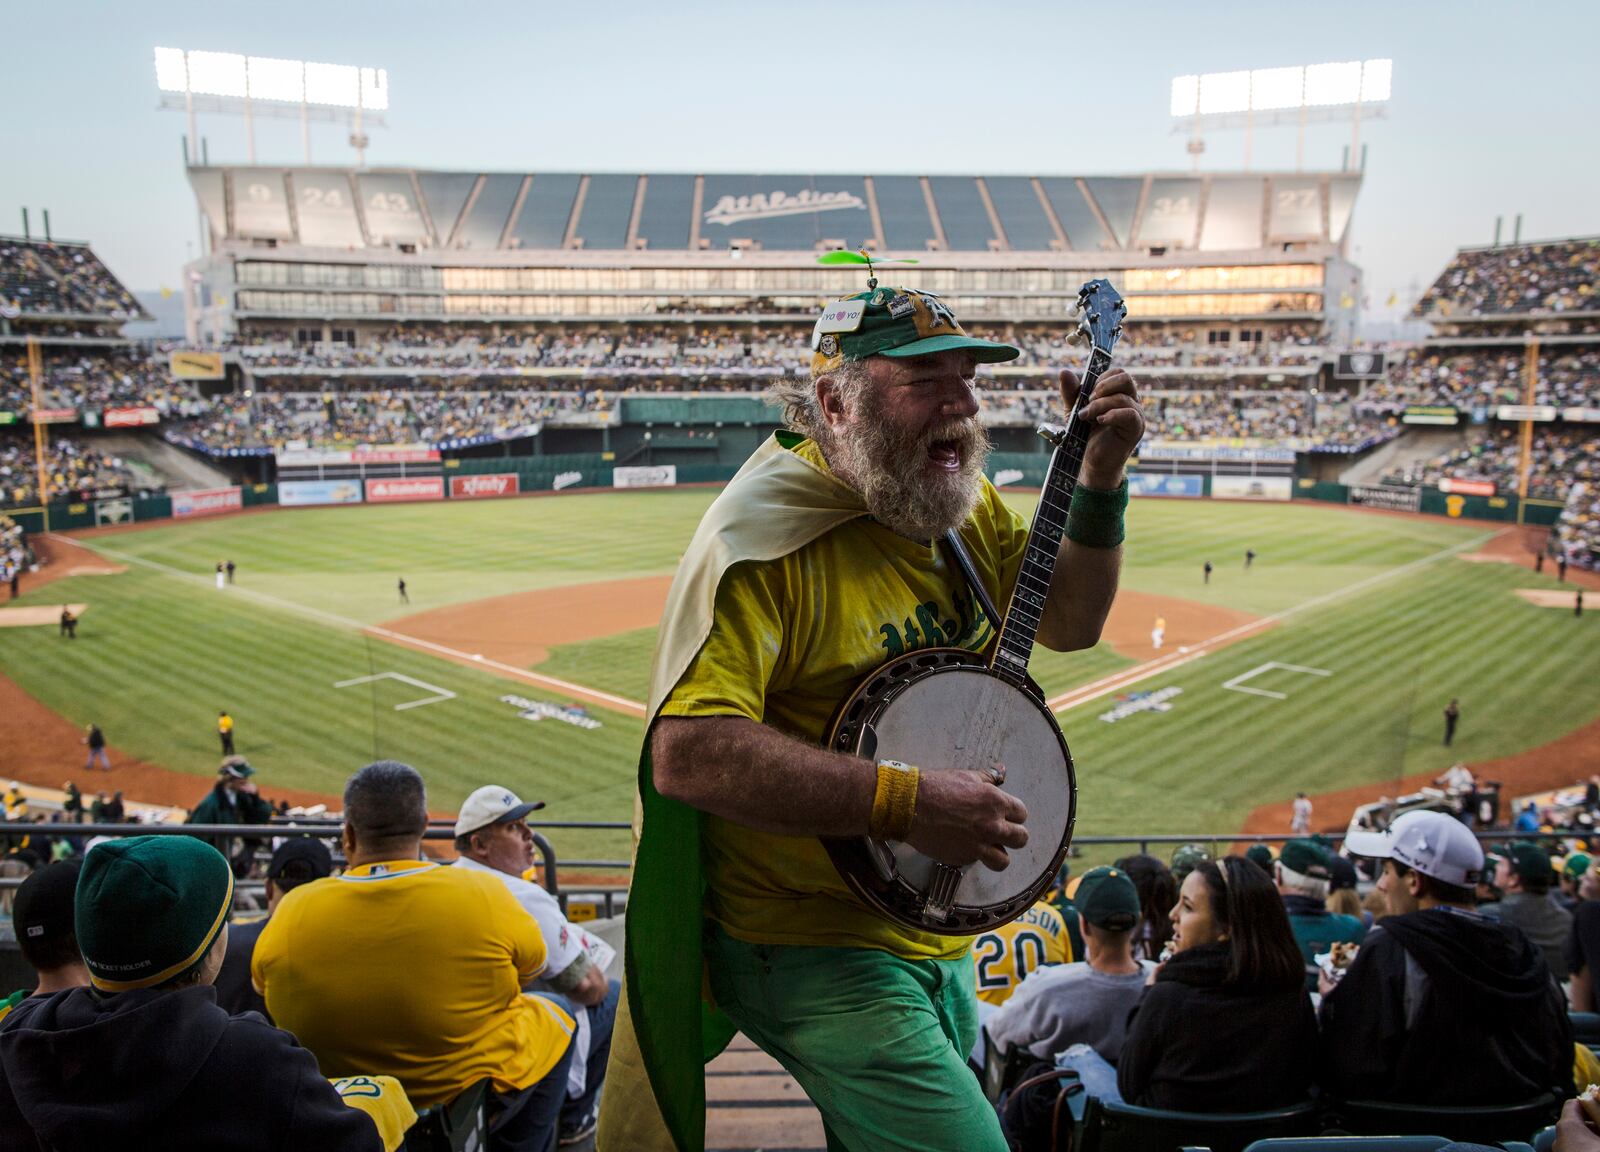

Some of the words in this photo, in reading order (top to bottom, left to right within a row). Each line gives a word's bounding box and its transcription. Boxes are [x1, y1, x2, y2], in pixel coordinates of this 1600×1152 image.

[303, 187, 344, 207] 24
[370, 192, 409, 212] 43
[704, 189, 867, 225] Athletics
[1278, 189, 1316, 208] 27
[120, 959, 152, 972] HOLDER
[974, 931, 1046, 990] 20
